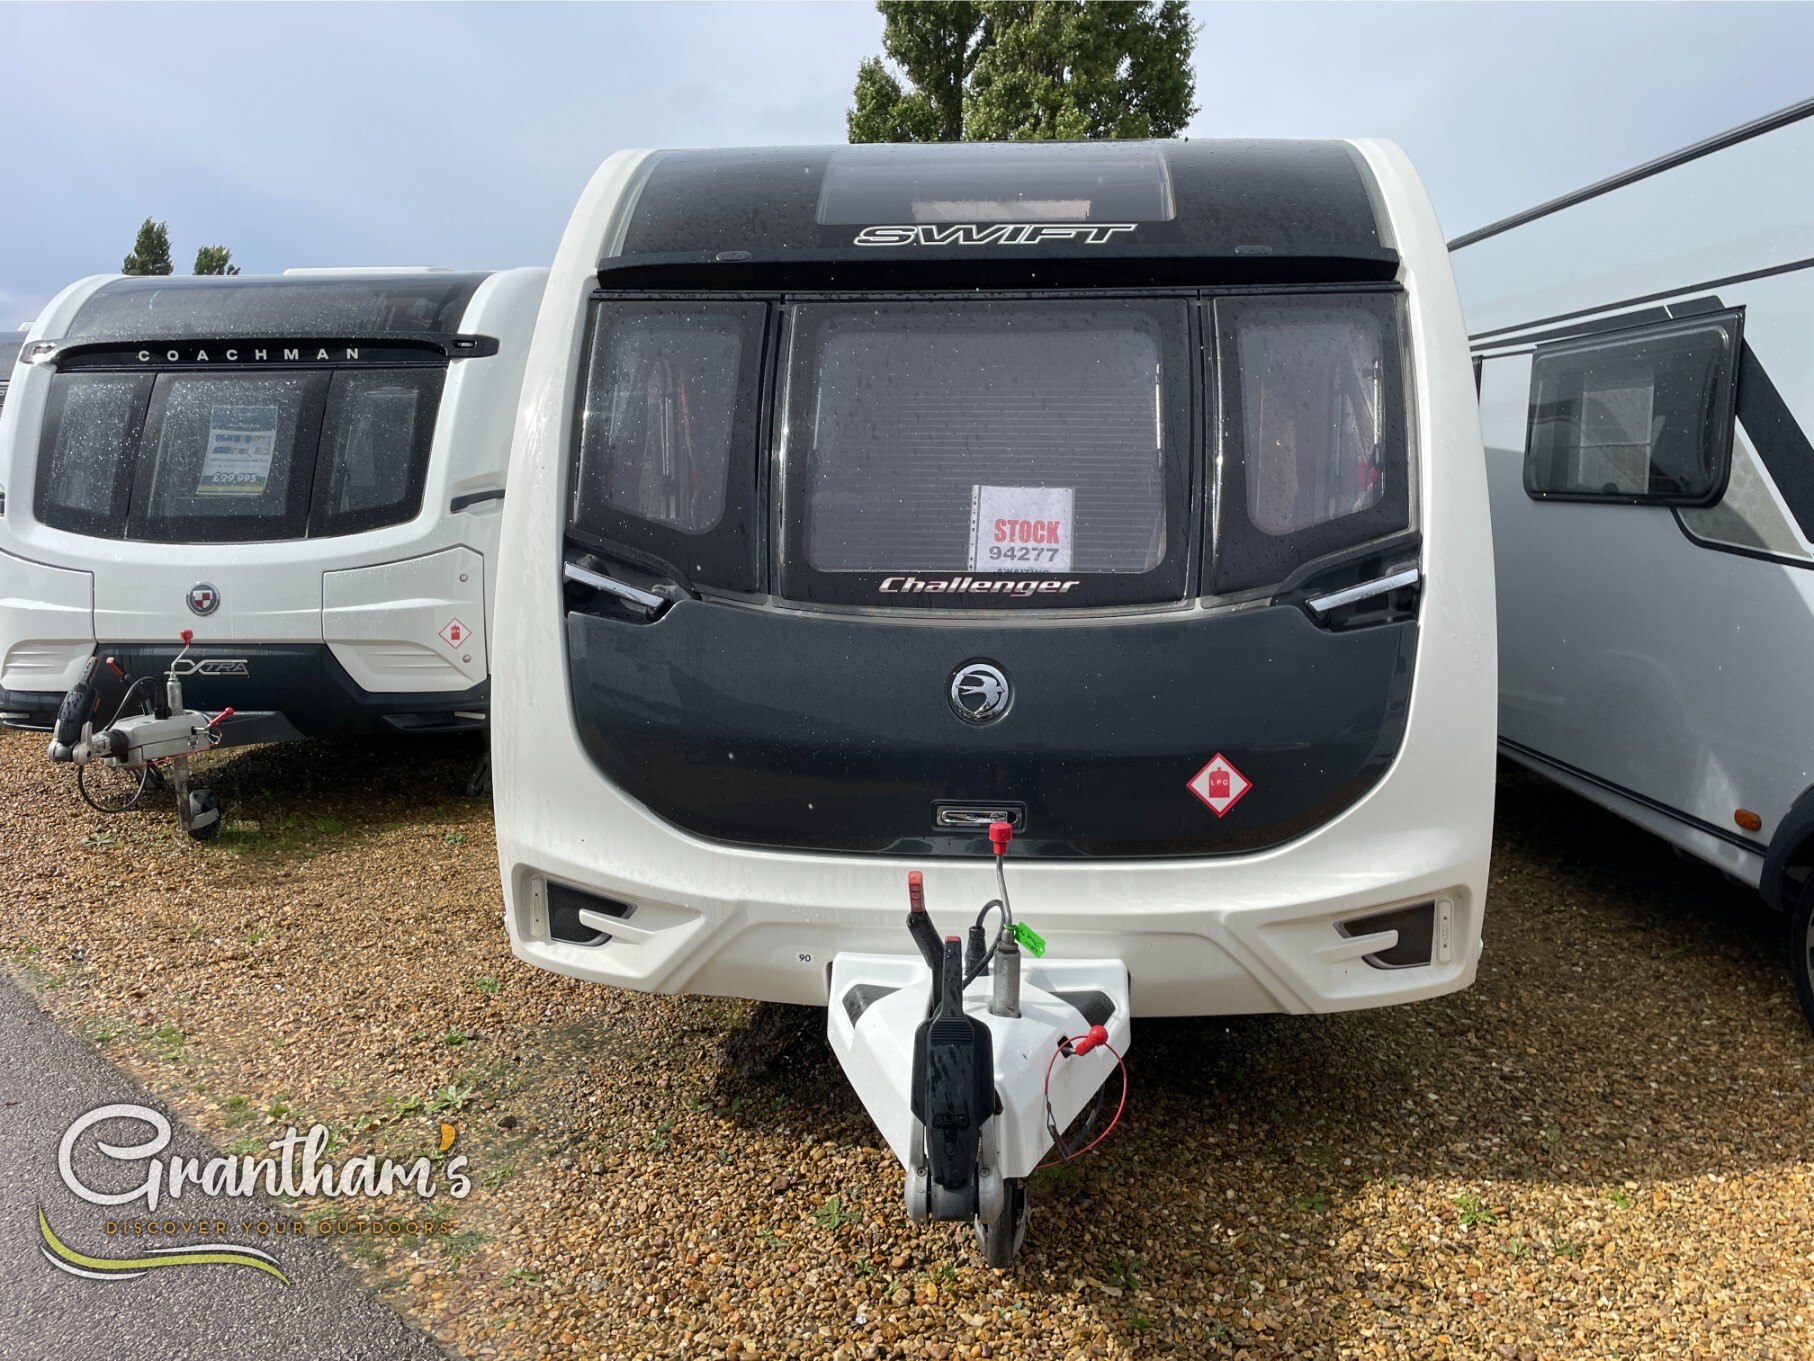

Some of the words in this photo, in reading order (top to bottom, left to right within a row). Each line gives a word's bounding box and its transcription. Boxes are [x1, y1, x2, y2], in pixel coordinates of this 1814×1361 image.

[853, 223, 1138, 246] SWIFT
[138, 348, 359, 361] COACHMAN
[993, 518, 1060, 544] STOCK
[989, 546, 1059, 562] 94277
[878, 576, 1080, 597] Challenger
[1210, 779, 1229, 787] LPG
[798, 953, 811, 963] 90
